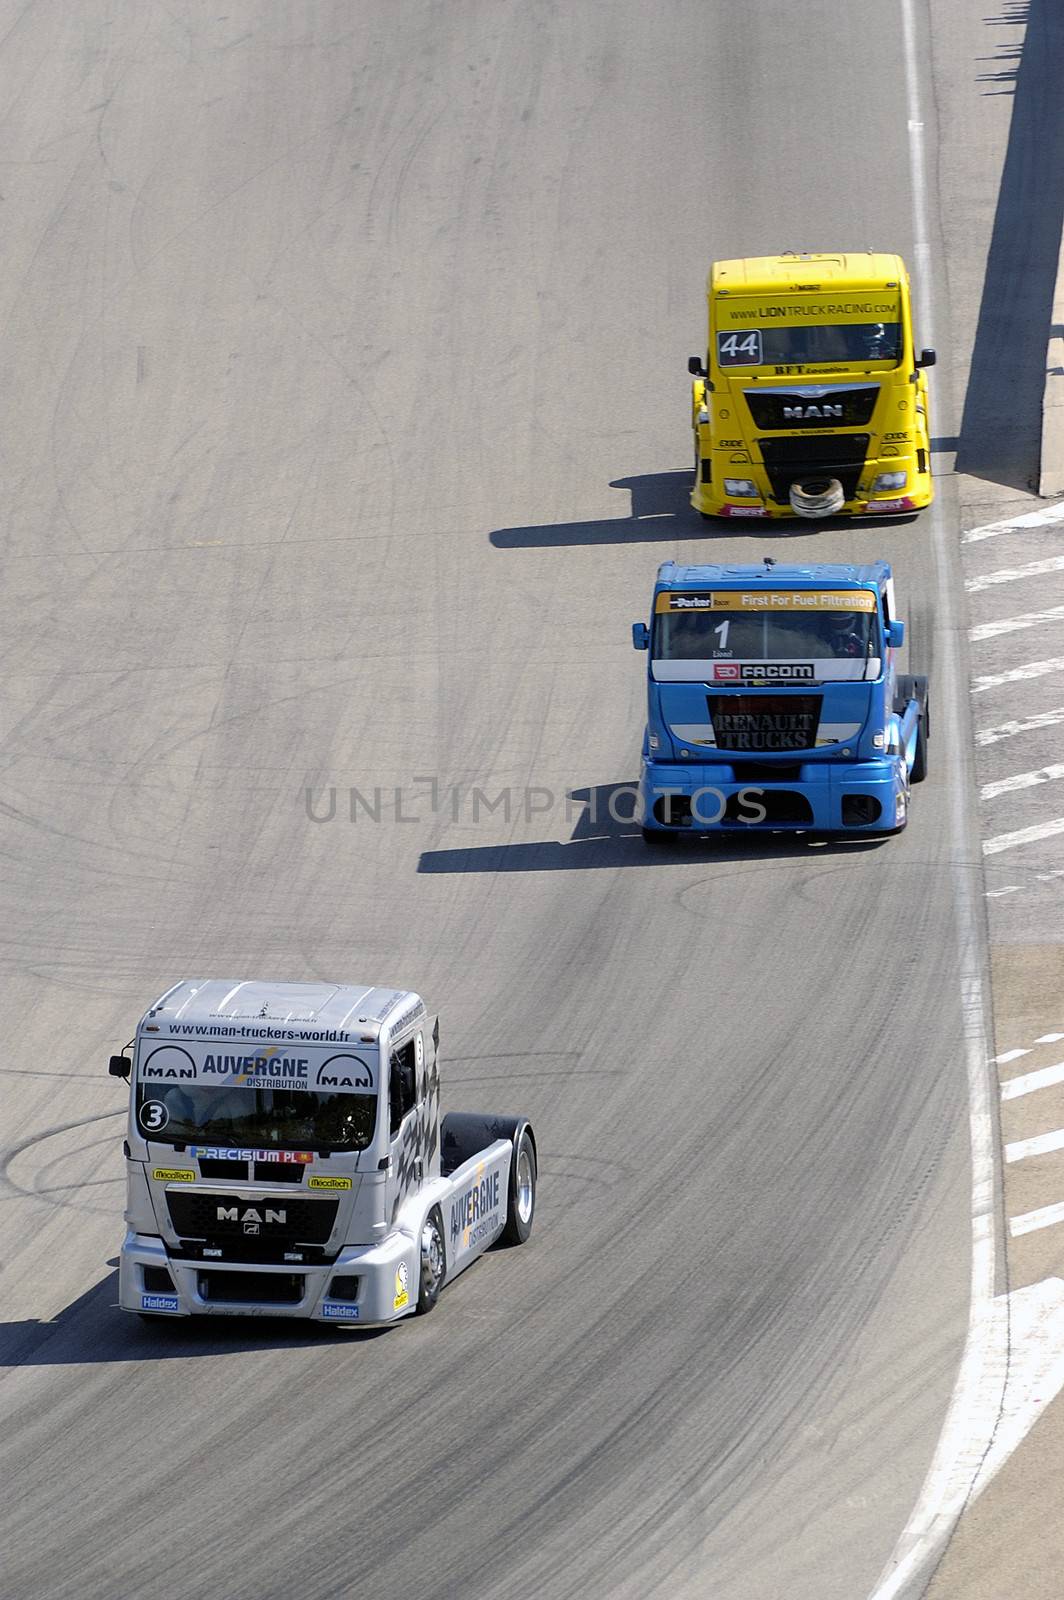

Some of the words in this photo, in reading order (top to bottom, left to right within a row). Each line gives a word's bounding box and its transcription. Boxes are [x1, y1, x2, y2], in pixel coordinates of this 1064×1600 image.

[720, 334, 758, 356] 44
[774, 365, 805, 375] BFT
[783, 404, 843, 418] MAN
[677, 597, 711, 607] Parker
[742, 594, 768, 606] First
[772, 594, 790, 606] For
[793, 594, 817, 606] Fuel
[821, 594, 872, 607] Filtration
[714, 620, 730, 649] 1
[742, 666, 812, 677] FACOM
[716, 714, 813, 731] RENAULT
[721, 732, 807, 748] TRUCKS
[169, 1024, 350, 1042] www.man-truckers-world.fr
[150, 1068, 194, 1078] MAN
[203, 1055, 308, 1078] AUVERGNE
[246, 1079, 308, 1089] DISTRIBUTION
[320, 1076, 370, 1088] MAN
[147, 1106, 163, 1127] 3
[196, 1147, 280, 1162] PRECISIUM
[283, 1152, 297, 1162] PL
[217, 1207, 287, 1223] MAN
[450, 1171, 500, 1244] AUVERGNE
[468, 1213, 499, 1248] DISTRIBUTION
[143, 1298, 178, 1310] Haldex
[323, 1305, 359, 1318] Haldex
